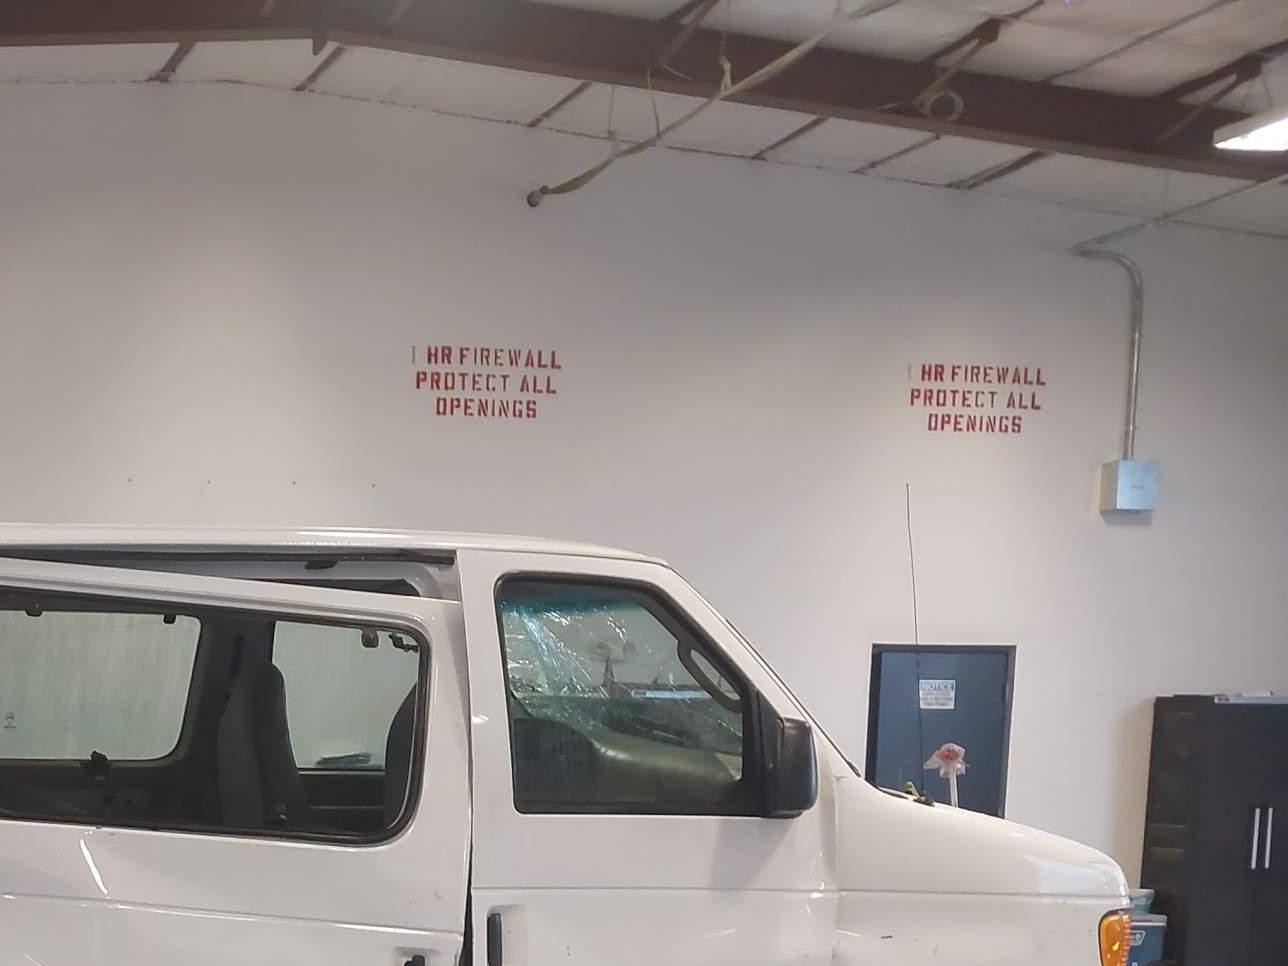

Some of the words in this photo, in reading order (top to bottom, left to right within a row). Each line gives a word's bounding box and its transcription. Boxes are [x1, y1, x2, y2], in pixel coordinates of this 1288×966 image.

[427, 345, 452, 365] HR
[459, 346, 561, 370] FIREWALL
[416, 370, 510, 392] PROTECT
[519, 374, 557, 395] ALL
[921, 363, 945, 383] HR
[951, 364, 1046, 387] FIREWALL
[436, 397, 537, 419] OPENINGS
[910, 387, 998, 409] PROTECT
[1006, 391, 1041, 411] ALL
[927, 412, 1022, 434] OPENINGS
[920, 681, 954, 690] NOTICE
